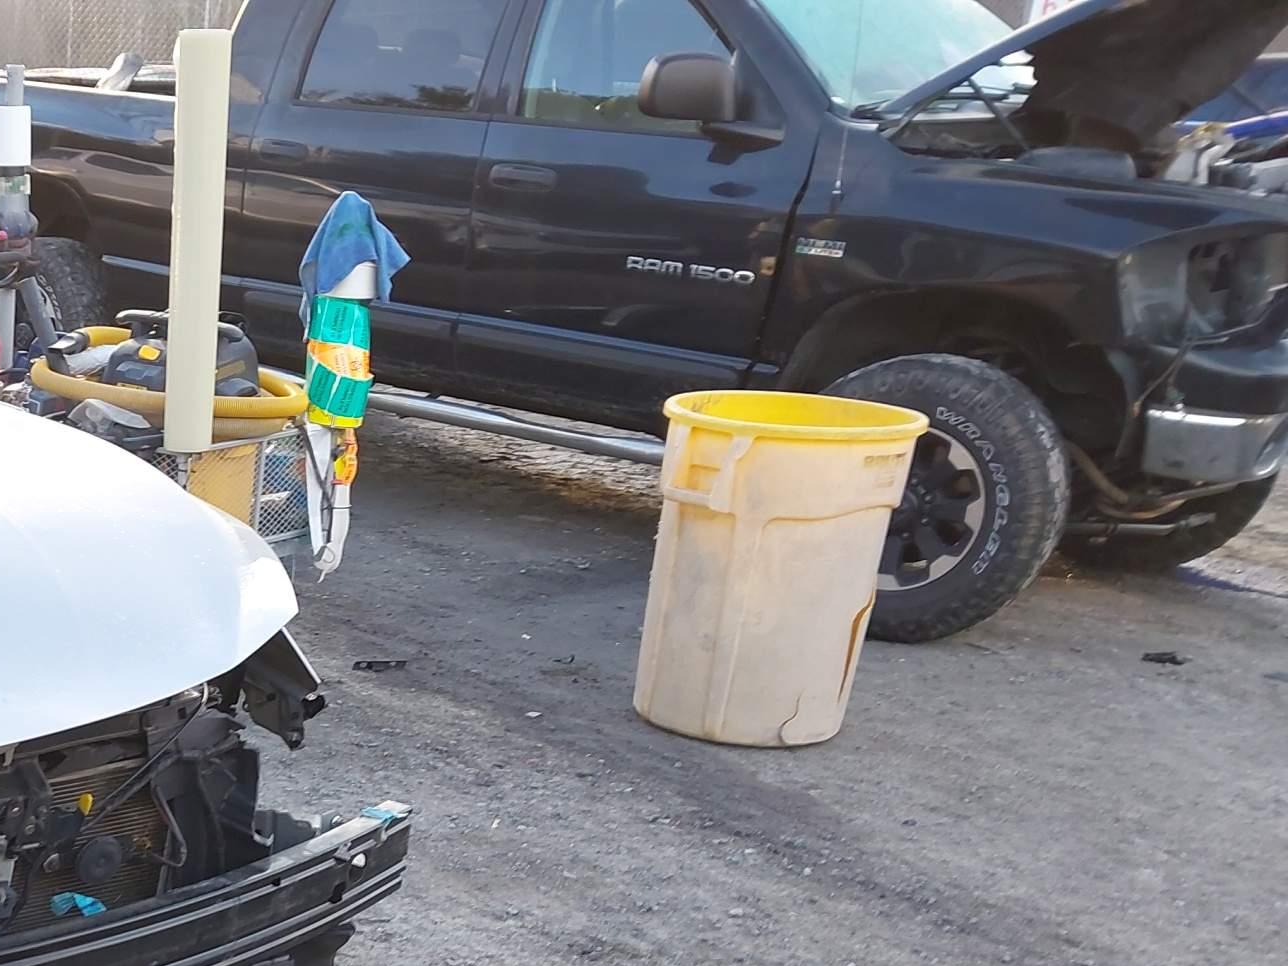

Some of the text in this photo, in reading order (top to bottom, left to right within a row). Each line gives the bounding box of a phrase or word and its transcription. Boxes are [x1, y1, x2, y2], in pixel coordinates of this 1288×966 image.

[626, 255, 755, 284] RAM 1500
[936, 406, 1010, 575] WRANGLER
